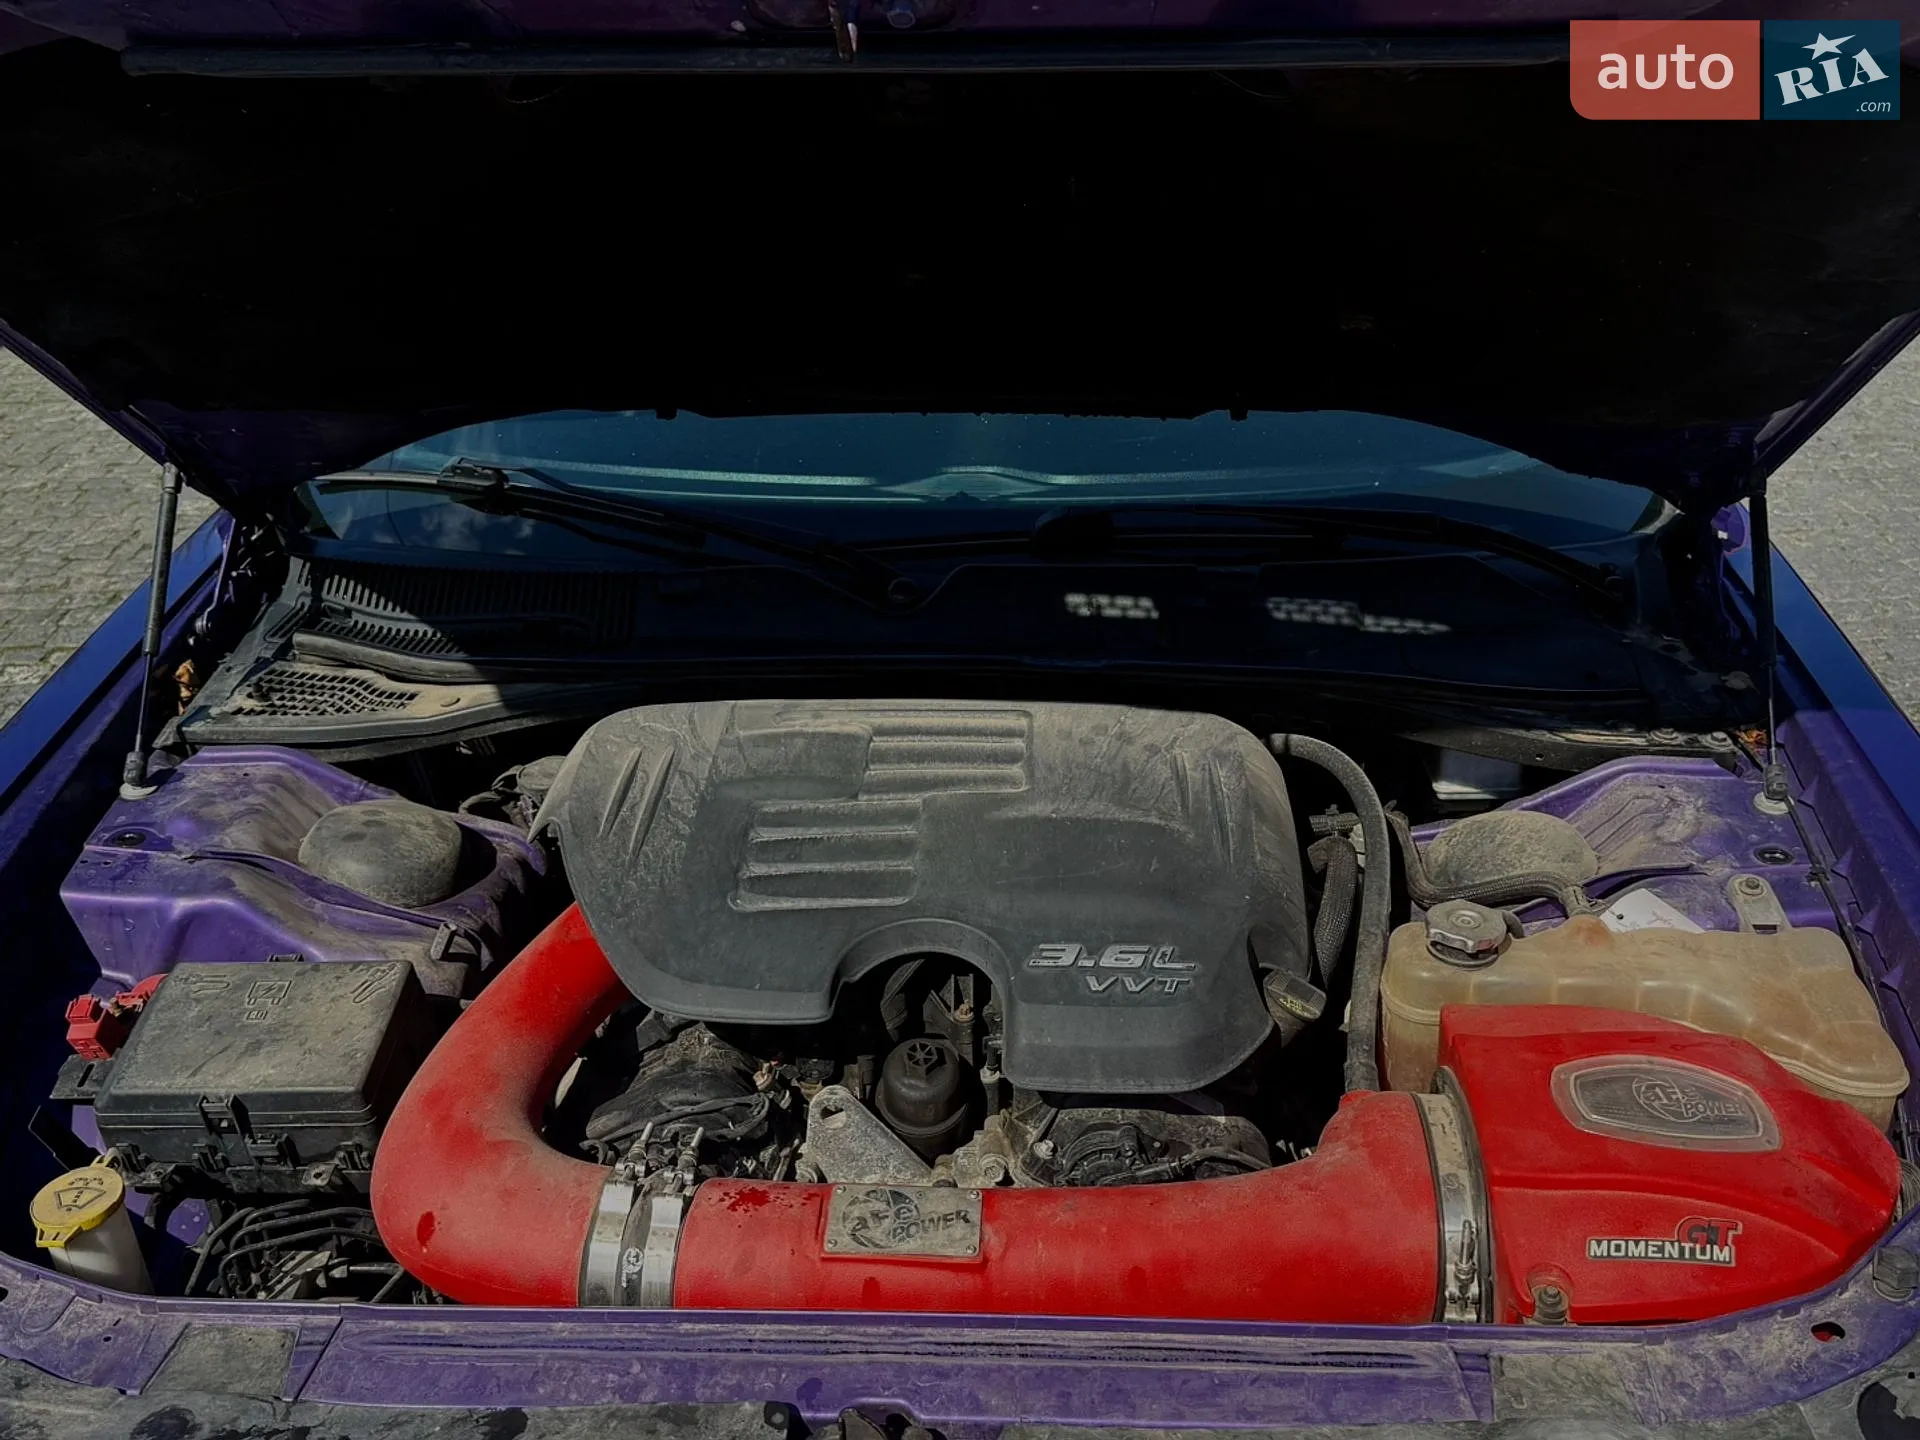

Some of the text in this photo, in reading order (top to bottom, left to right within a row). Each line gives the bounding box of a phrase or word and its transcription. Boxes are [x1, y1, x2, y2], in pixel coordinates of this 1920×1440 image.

[1028, 942, 1196, 969] 3.6L
[1085, 975, 1191, 995] VVT
[891, 1208, 971, 1241] POWER
[1677, 1216, 1740, 1248] GT
[1589, 1239, 1731, 1262] MOMENTUM
